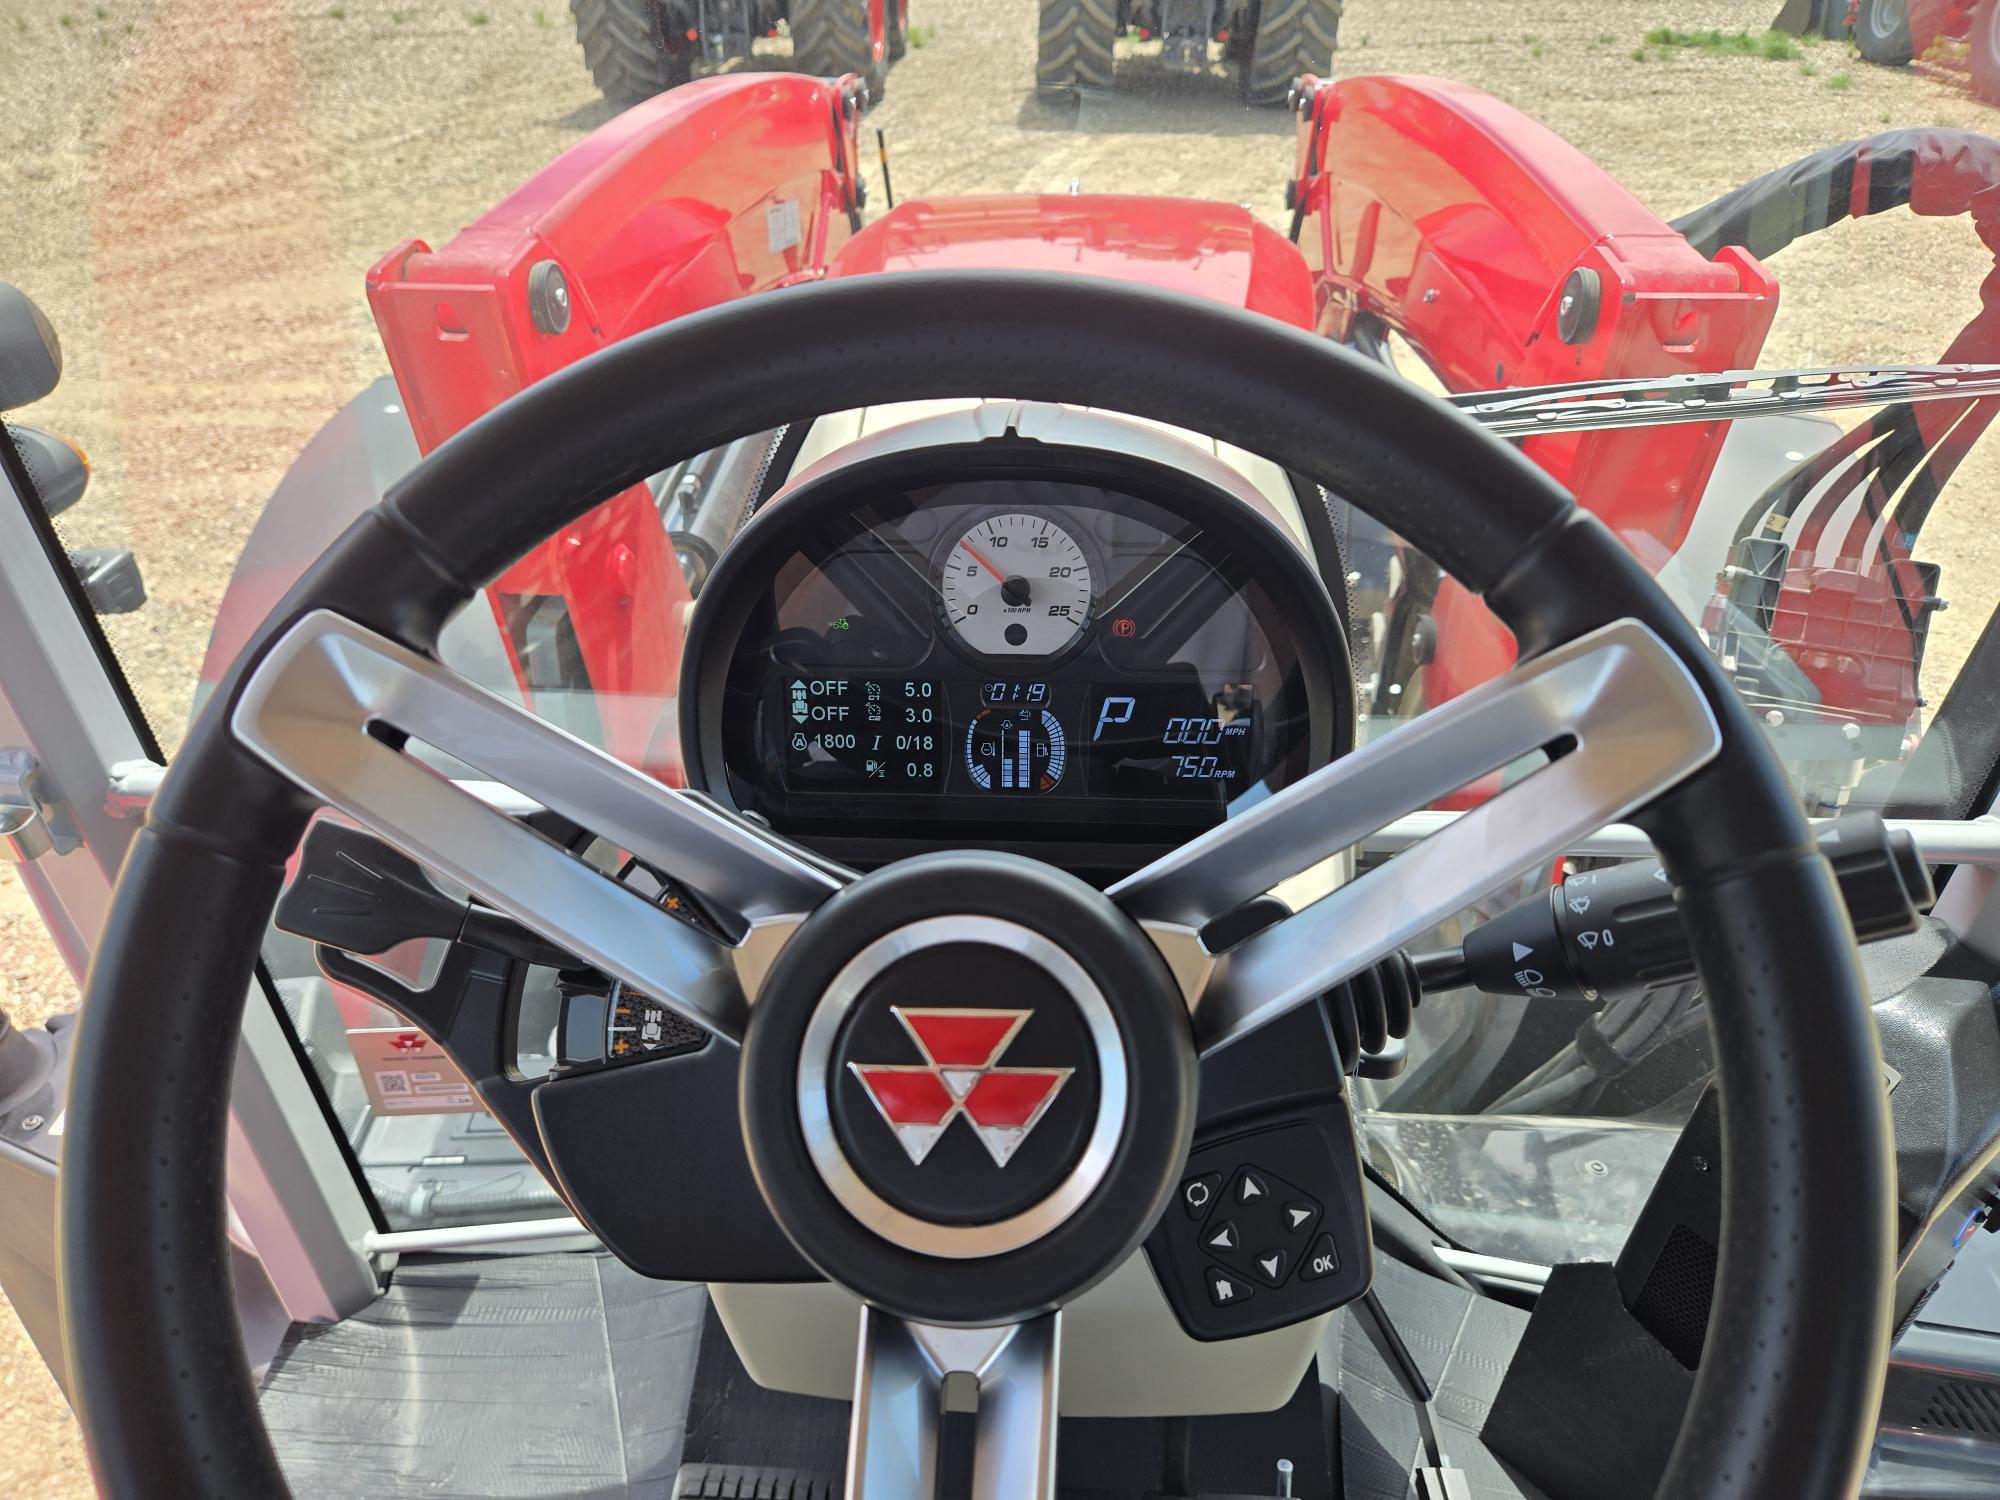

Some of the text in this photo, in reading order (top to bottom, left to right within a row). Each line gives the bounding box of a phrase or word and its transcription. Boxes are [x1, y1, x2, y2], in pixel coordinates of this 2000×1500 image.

[989, 536, 1009, 548] 10
[1031, 537, 1049, 548] 15
[966, 566, 978, 577] 5
[1048, 566, 1072, 578] 20
[966, 604, 978, 615] 0
[1048, 605, 1071, 617] 25
[810, 680, 848, 696] OFF
[904, 682, 932, 698] 5.0
[990, 682, 1046, 702] 01:19
[811, 706, 850, 721] OFF
[905, 708, 933, 723] 3.0
[1093, 696, 1136, 742] P
[1224, 727, 1247, 736] MPH
[814, 733, 856, 749] 1800
[895, 735, 934, 751] 0/18
[906, 762, 934, 778] 0.8
[1171, 755, 1236, 779] 750 RPM
[1312, 1254, 1335, 1274] OK
